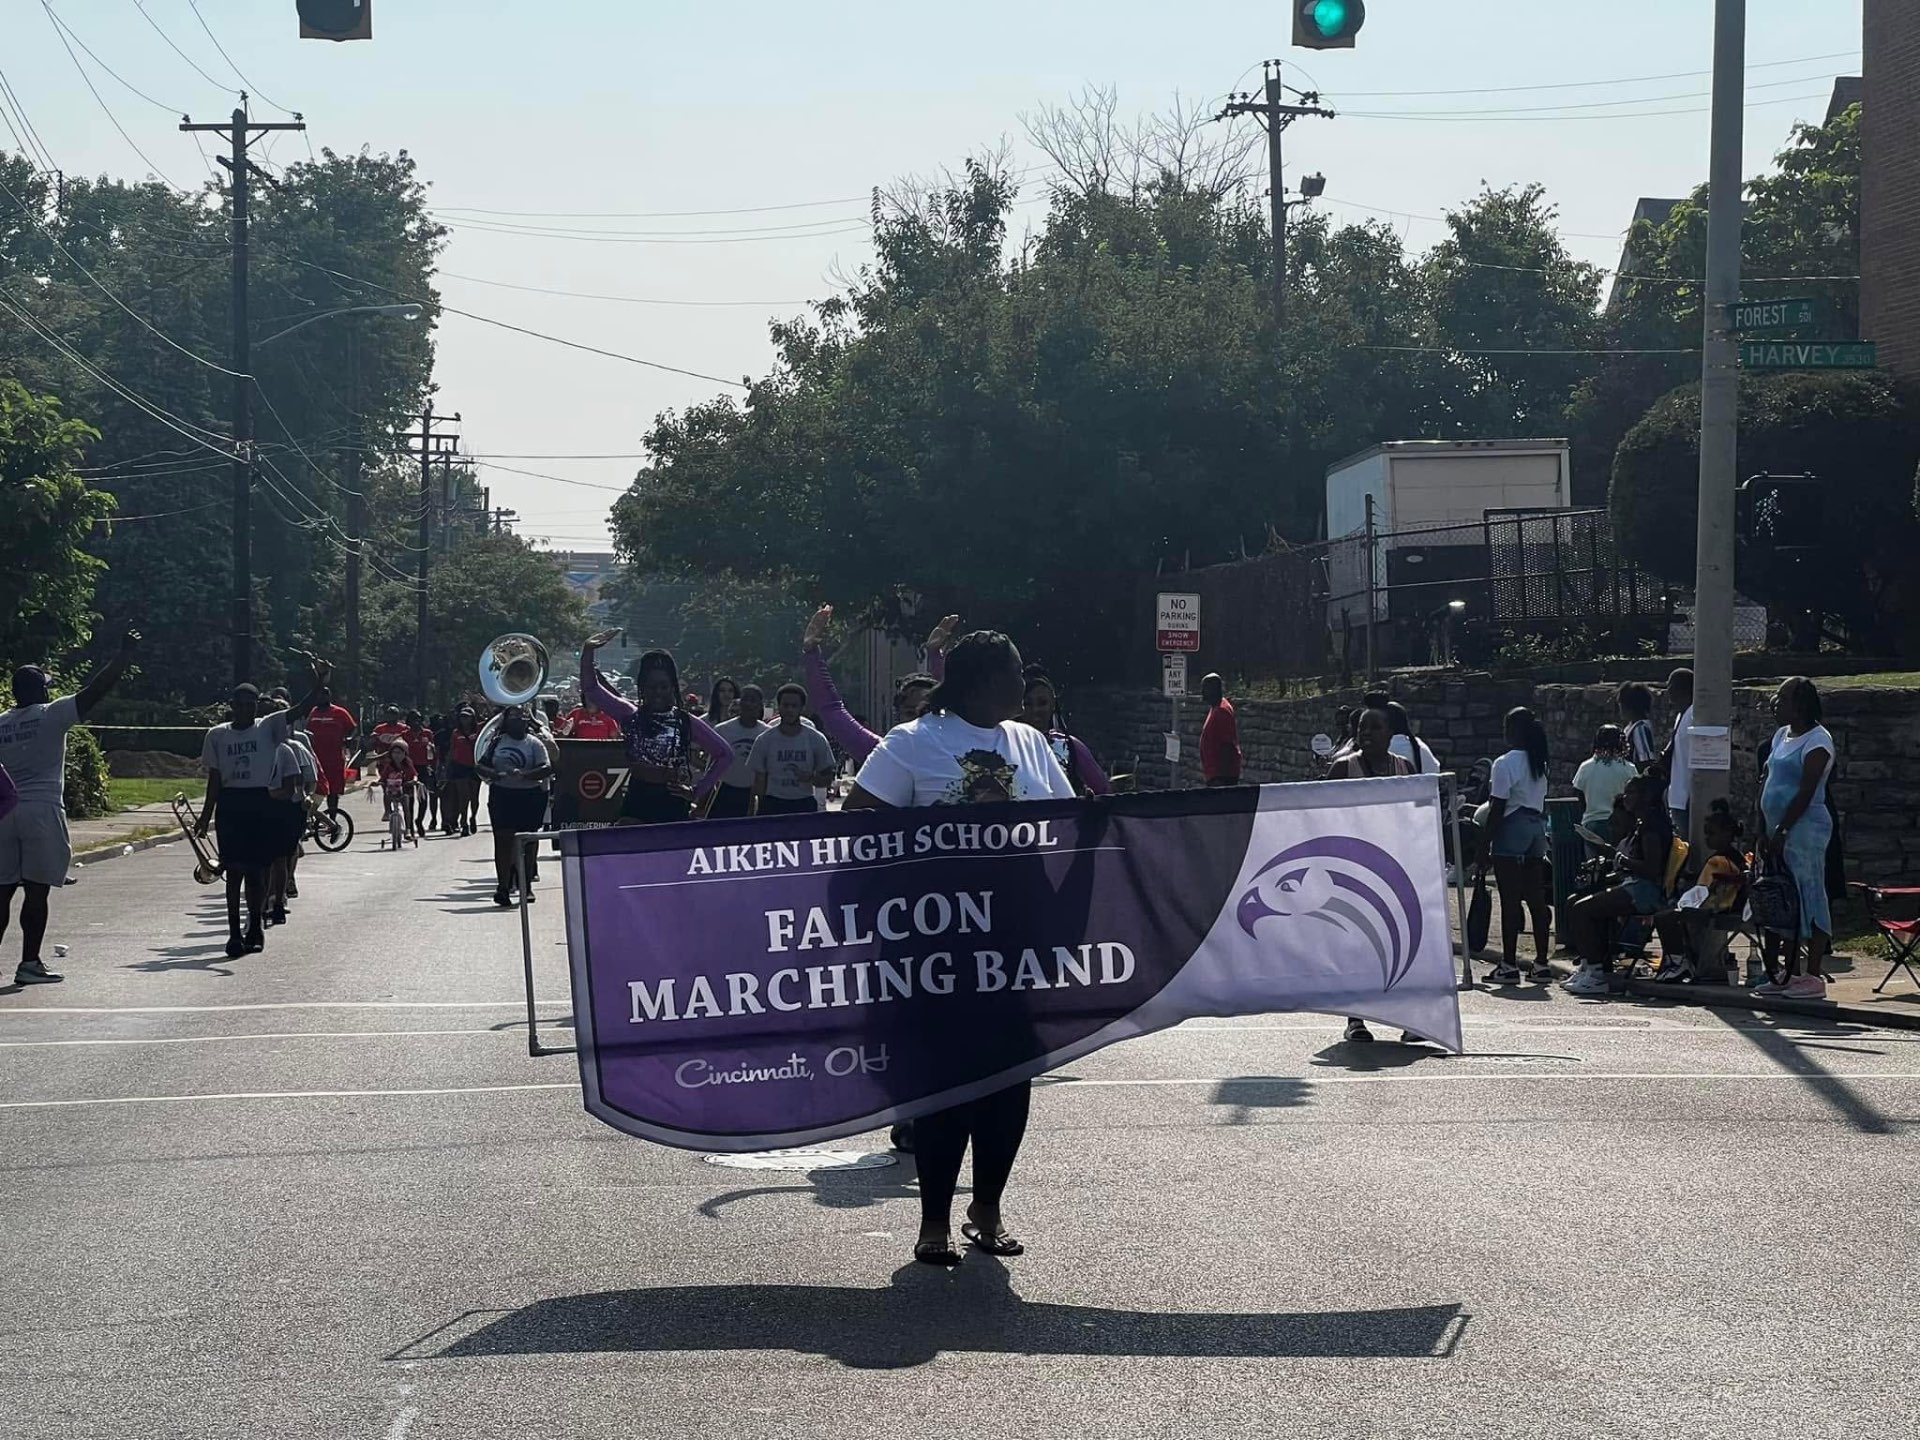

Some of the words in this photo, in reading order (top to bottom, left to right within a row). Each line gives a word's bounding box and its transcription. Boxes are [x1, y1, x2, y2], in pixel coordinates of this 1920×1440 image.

[1735, 304, 1788, 328] FOREST
[1749, 345, 1841, 365] HARVEY
[1170, 599, 1187, 610] NO
[1160, 611, 1197, 621] PARKING
[1167, 631, 1189, 639] SNOW
[1161, 639, 1194, 647] EMERGENCY
[1168, 670, 1181, 679] ANY
[1168, 680, 1182, 688] TIME
[226, 740, 257, 756] AIKEN
[777, 749, 808, 762] AIKEN
[686, 841, 801, 877] AIKEN
[810, 831, 905, 867] HIGH
[913, 820, 1059, 854] SCHOOL
[765, 890, 994, 954] FALCON
[627, 950, 957, 1024] MARCHING
[973, 941, 1137, 994] BAND
[674, 1050, 815, 1089] Cincinnati,
[823, 1042, 892, 1077] OH
